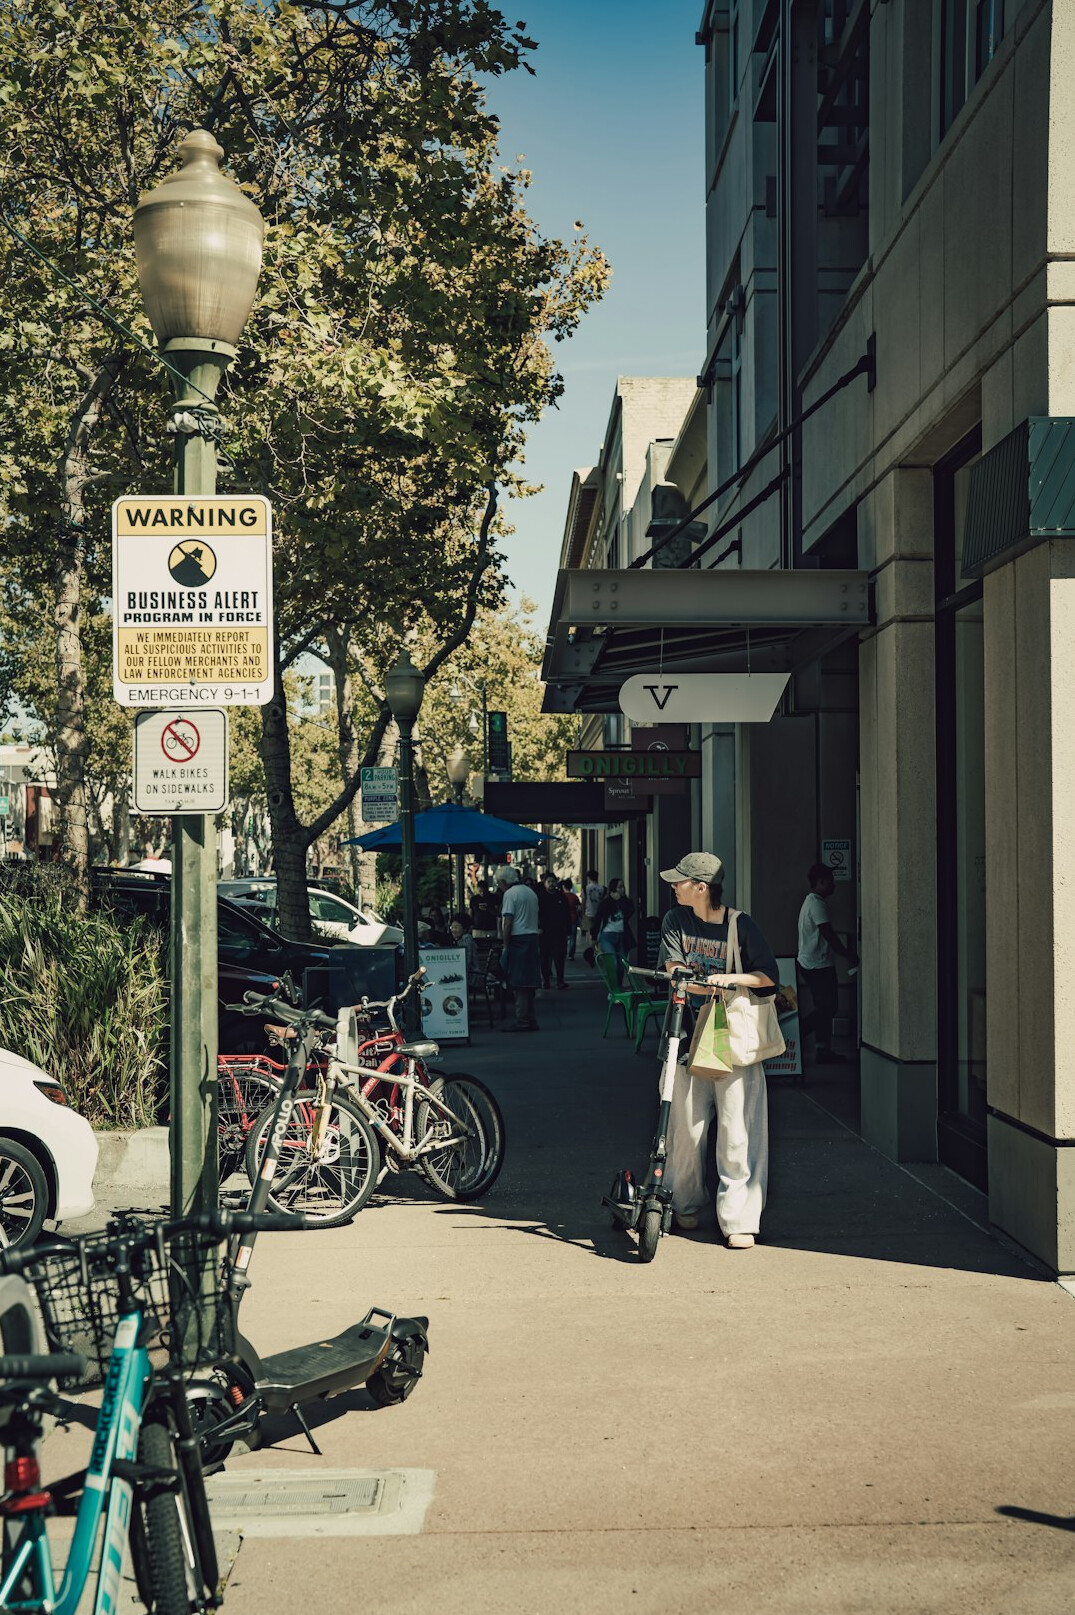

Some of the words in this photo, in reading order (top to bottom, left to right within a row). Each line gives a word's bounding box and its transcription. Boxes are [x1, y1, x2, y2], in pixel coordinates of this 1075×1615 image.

[126, 507, 258, 527] WARNING
[127, 591, 207, 610] BUSINESS
[214, 591, 258, 609] ALERT
[123, 612, 193, 623] PROGRAM
[199, 612, 213, 622] IN
[219, 612, 262, 622] FORCE
[136, 632, 150, 643] WE
[153, 632, 212, 643] IMMEDIATELY
[215, 631, 250, 642] REPORT
[124, 644, 139, 655] ALL
[143, 644, 197, 655] SUSPICIOUS
[200, 643, 248, 654] ACTIVITIES
[251, 643, 262, 654] TO
[126, 656, 144, 667] OUR
[147, 656, 182, 667] FELLOW
[185, 655, 239, 666] MERCHANTS
[243, 655, 261, 666] AND
[124, 668, 143, 679] LAW
[147, 668, 213, 679] ENFORCEMENT
[217, 667, 263, 678] AGENCIES
[128, 688, 219, 701] EMERGENCY
[223, 688, 261, 700] 9-1-1
[643, 685, 679, 710] V
[578, 754, 689, 776] ONIGILLY
[152, 768, 177, 779] WALK
[179, 768, 209, 779] BIKES
[364, 769, 372, 780] 2
[146, 784, 158, 794] ON
[161, 783, 215, 794] SIDEWALKS
[607, 786, 630, 796] Sprout
[425, 953, 461, 962] ONIGILLY
[90, 1354, 124, 1475] ROCKCREEK
